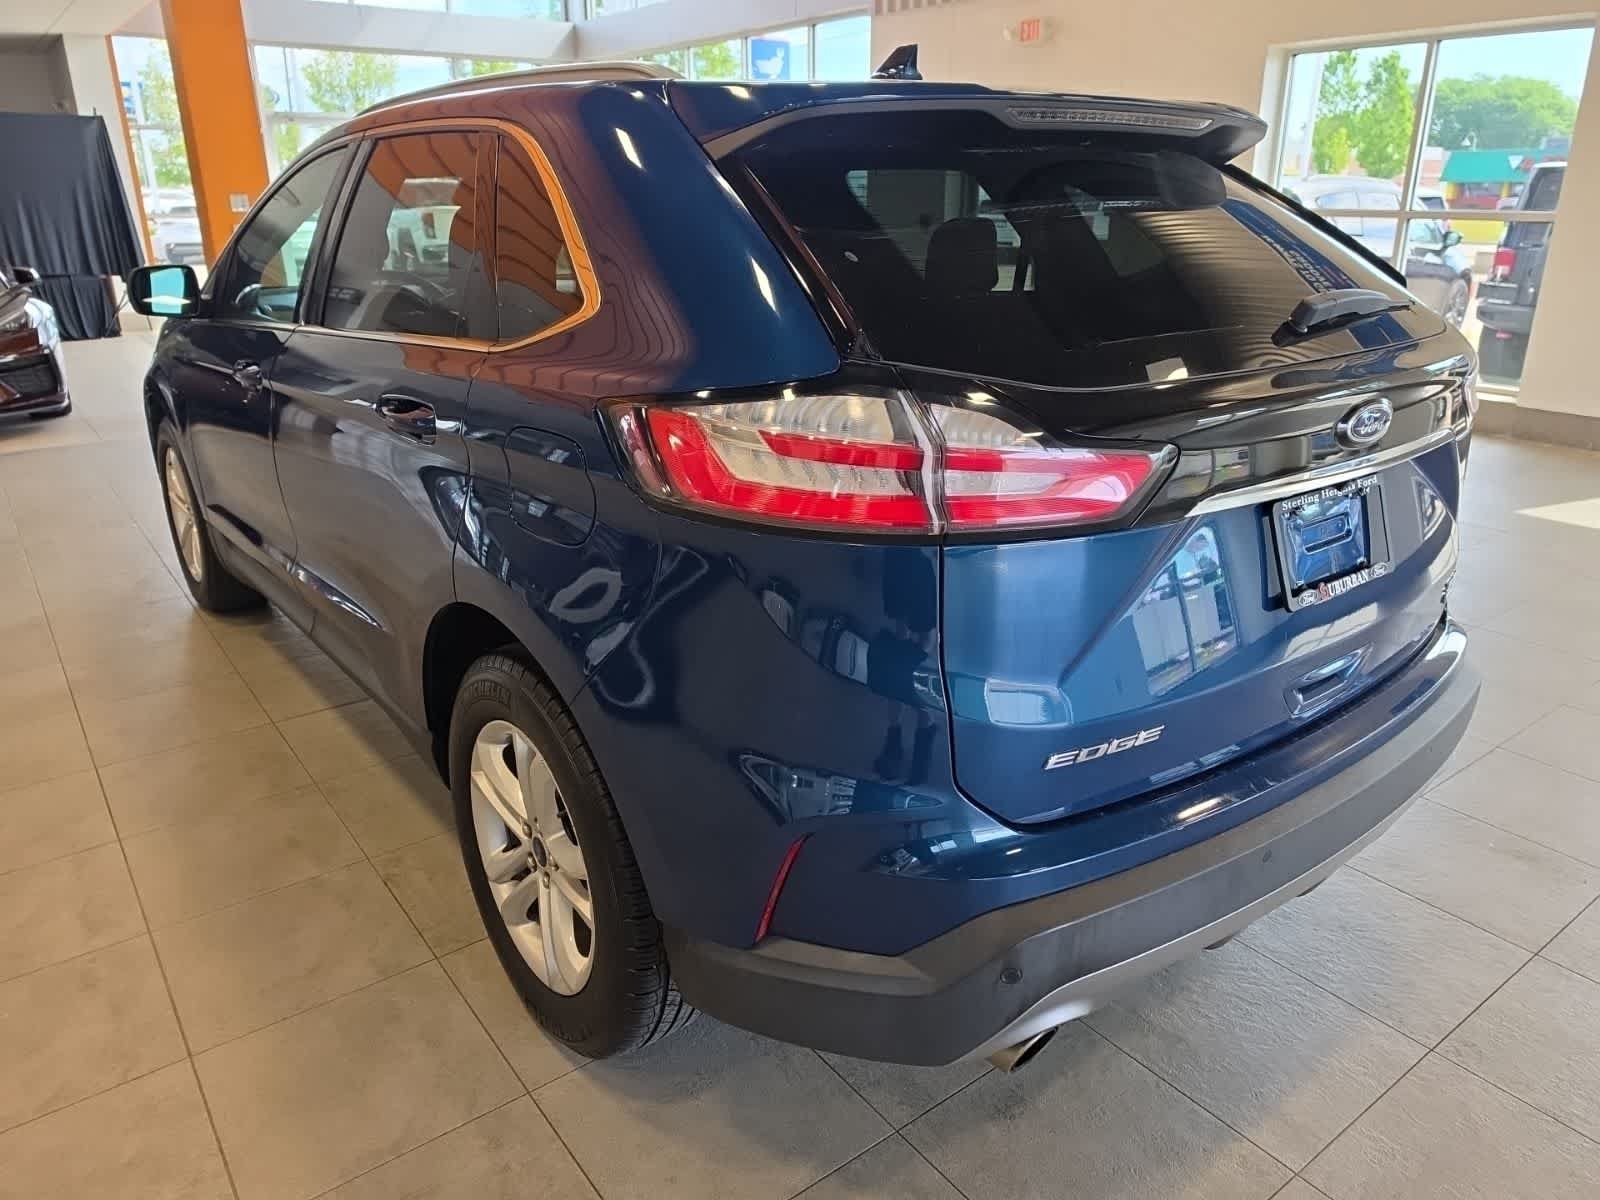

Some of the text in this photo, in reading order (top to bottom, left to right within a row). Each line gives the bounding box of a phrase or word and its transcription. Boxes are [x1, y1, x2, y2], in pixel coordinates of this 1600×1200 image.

[1282, 475, 1377, 511] Sterling Heigs Ford
[1317, 569, 1369, 600] SUBURBAN
[1044, 725, 1165, 770] EDGE
